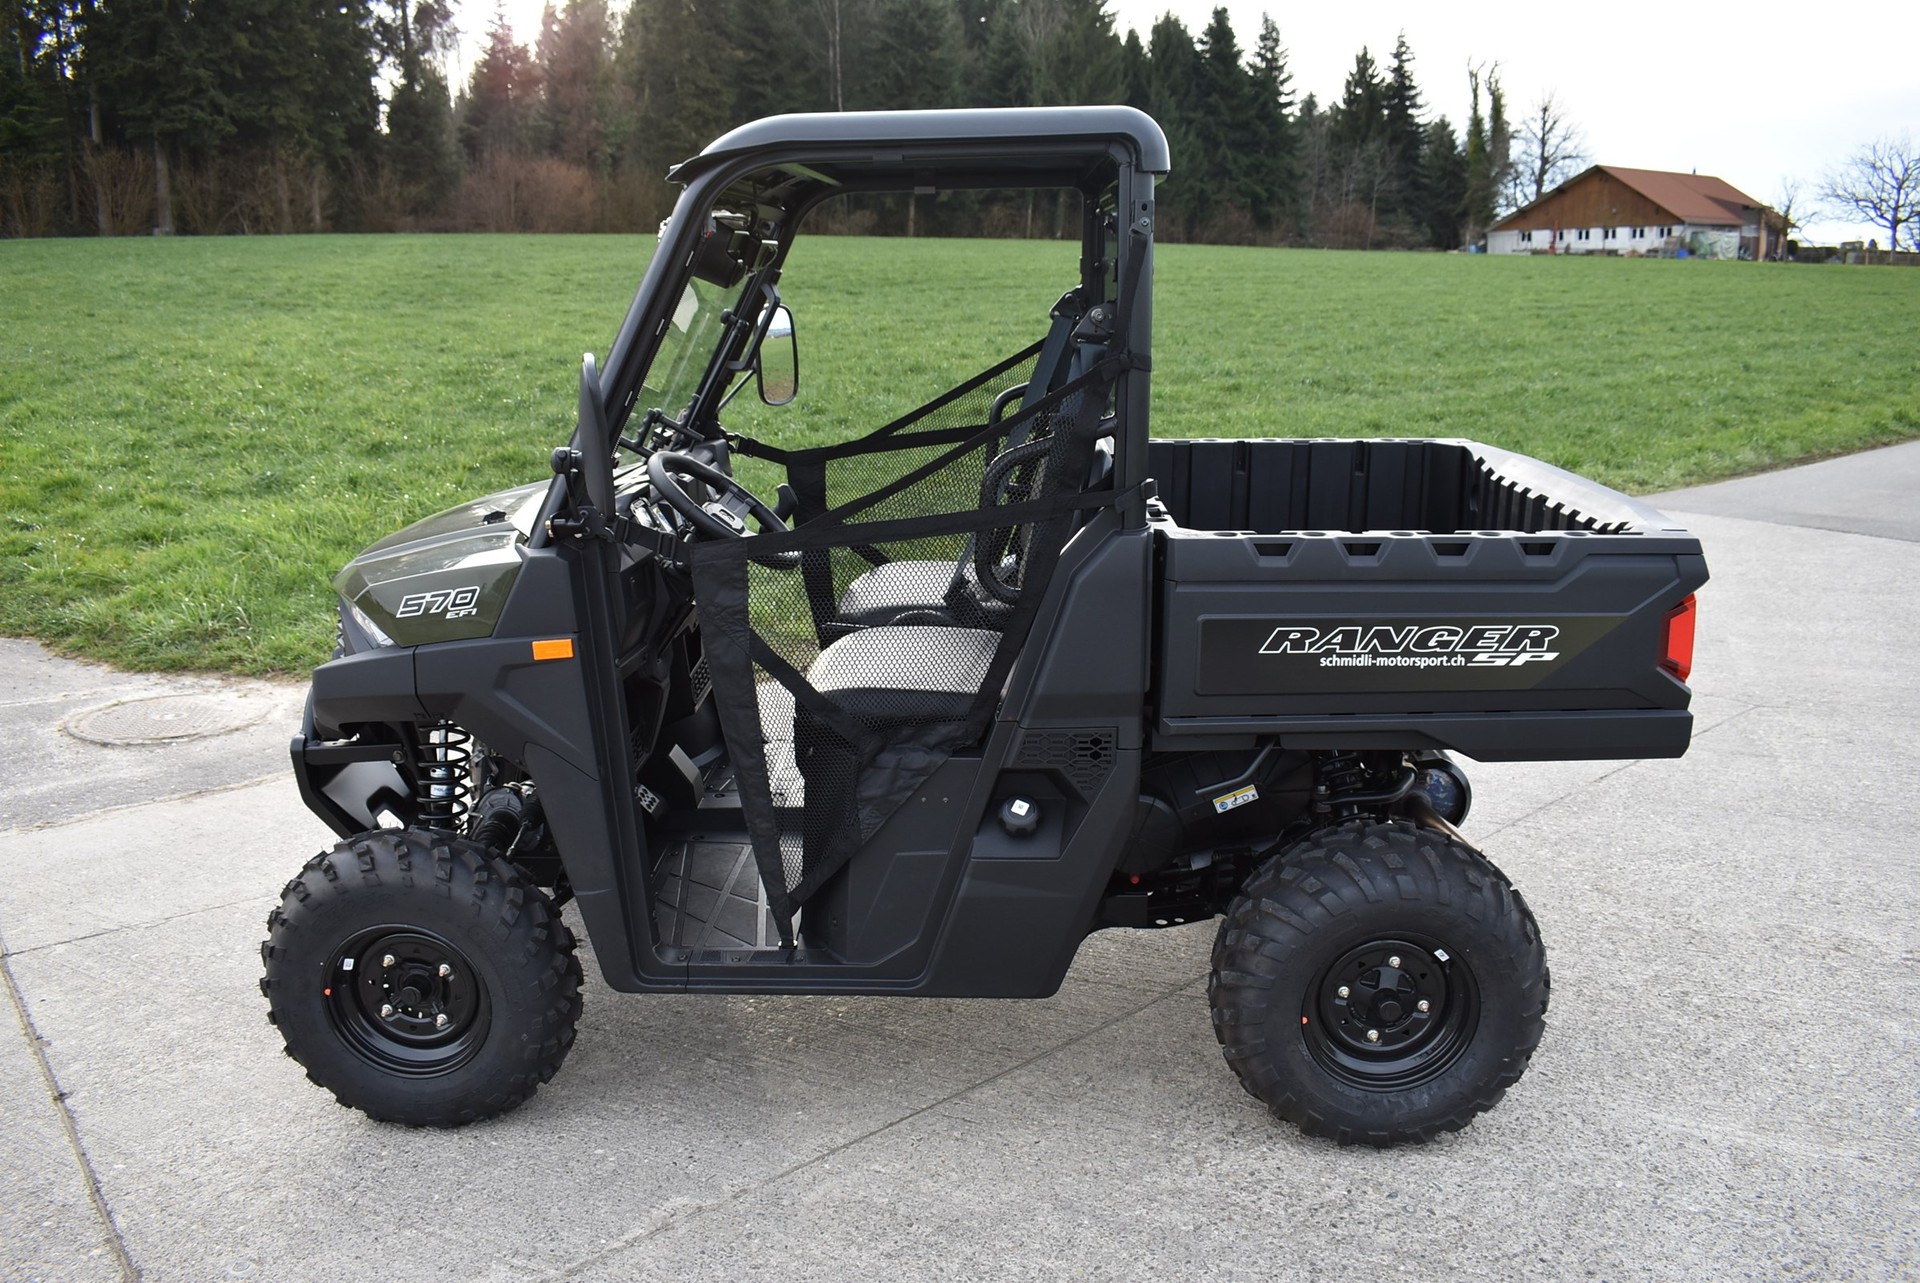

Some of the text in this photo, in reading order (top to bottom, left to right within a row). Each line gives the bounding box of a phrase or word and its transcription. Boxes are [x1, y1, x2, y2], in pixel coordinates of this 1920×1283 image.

[396, 586, 480, 618] 570
[446, 608, 477, 619] EFI
[1259, 625, 1559, 654] RANGER
[1320, 655, 1465, 669] schmidli-motorsport.ch
[1467, 652, 1560, 666] SP
